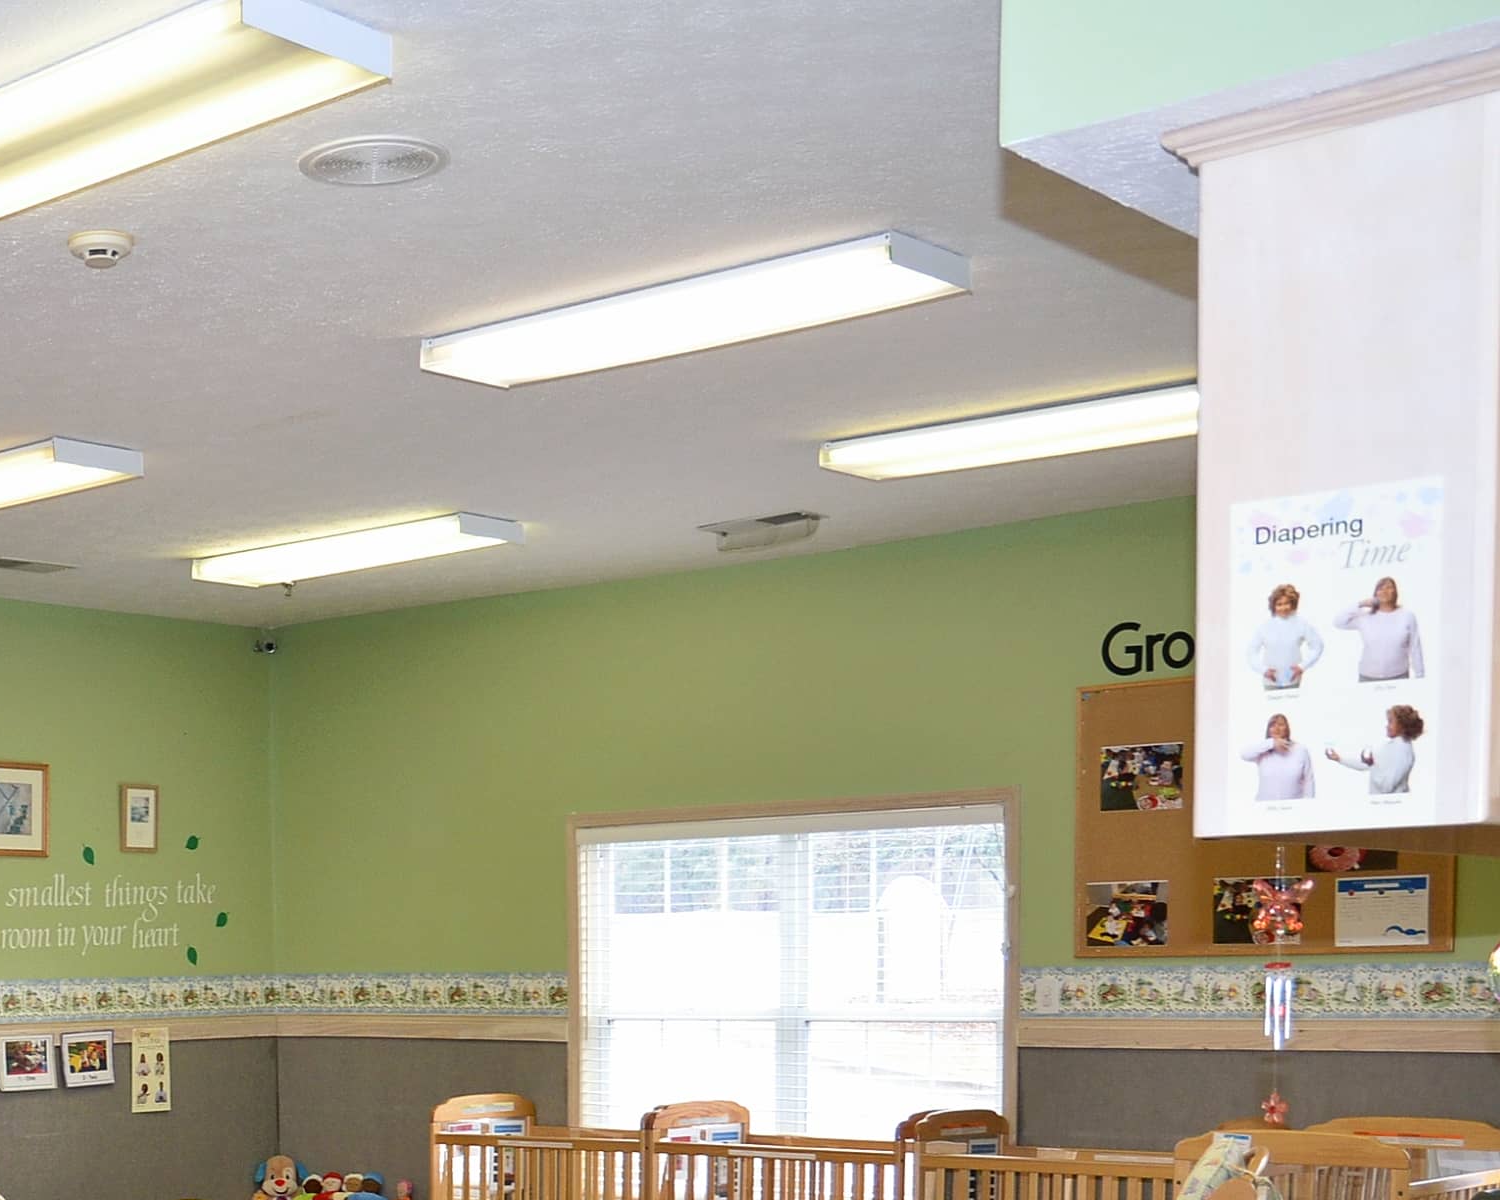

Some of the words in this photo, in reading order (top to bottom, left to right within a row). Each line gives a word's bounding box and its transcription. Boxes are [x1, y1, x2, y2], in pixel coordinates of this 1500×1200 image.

[1254, 517, 1364, 545] Diapering
[1339, 539, 1412, 569] Time
[1102, 621, 1195, 676] Gro
[5, 873, 92, 907] smallest
[105, 874, 169, 922] things
[176, 872, 217, 905] take
[1, 926, 50, 950] room
[57, 922, 76, 947] in
[81, 924, 127, 956] your
[132, 917, 180, 949] heart
